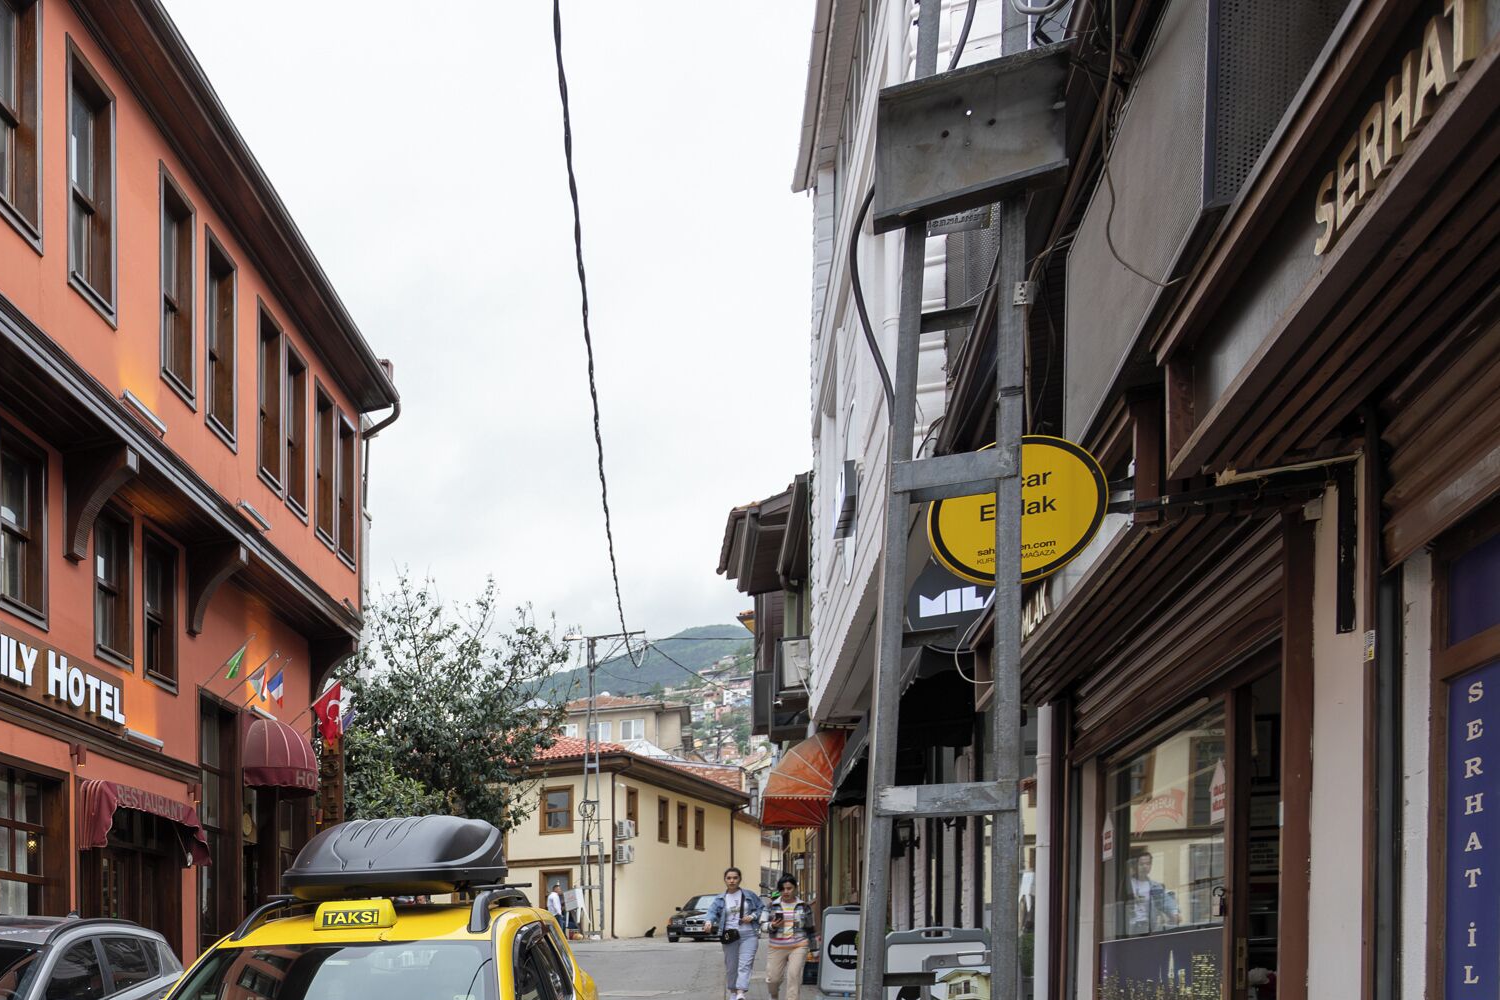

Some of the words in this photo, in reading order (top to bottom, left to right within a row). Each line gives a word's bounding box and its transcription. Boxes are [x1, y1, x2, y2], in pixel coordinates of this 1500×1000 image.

[1314, 0, 1466, 256] SERHAT
[980, 496, 1057, 522] Elak
[48, 649, 127, 726] HOTEL
[116, 785, 184, 819] RESTAURANT
[1464, 681, 1484, 888] SERHAT
